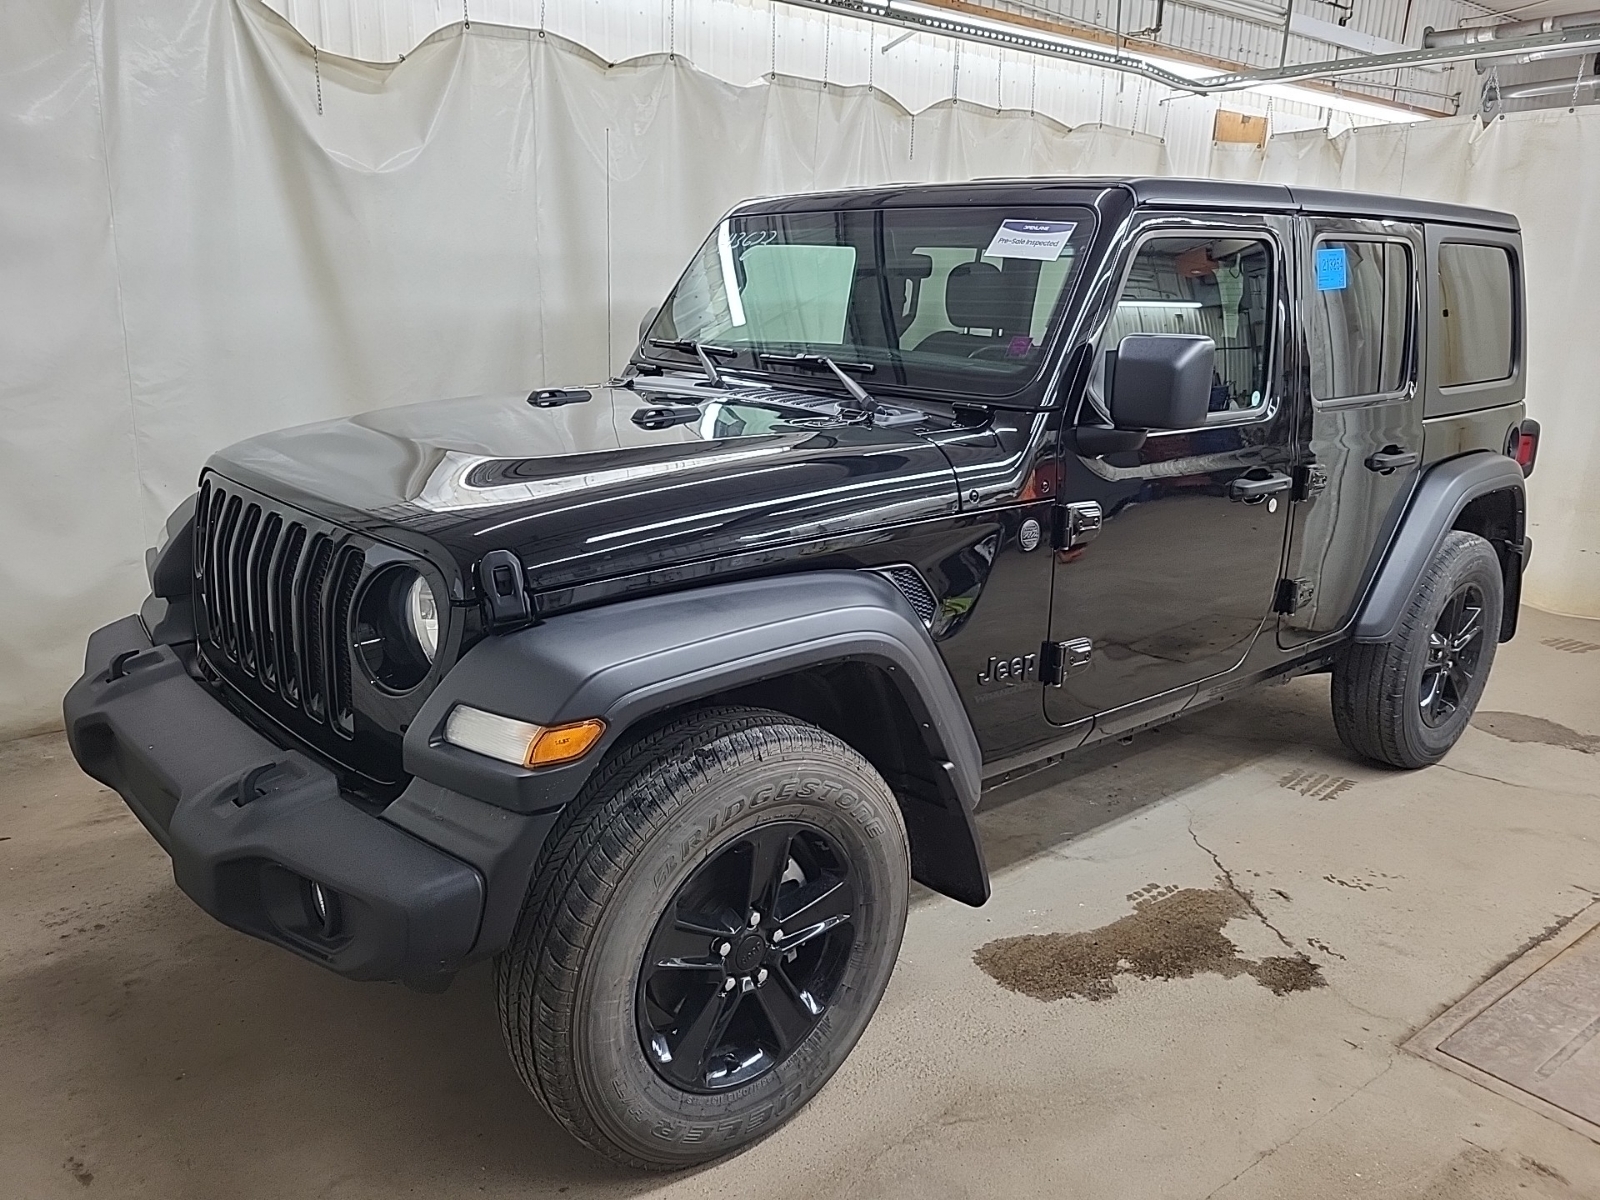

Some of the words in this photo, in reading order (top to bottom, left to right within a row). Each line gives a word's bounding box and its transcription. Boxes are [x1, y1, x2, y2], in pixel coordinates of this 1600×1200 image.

[997, 237, 1025, 245] Pre-Sale
[1025, 239, 1060, 248] Inspected
[977, 652, 1036, 687] Jeep
[652, 777, 886, 890] BRIDGESTONE
